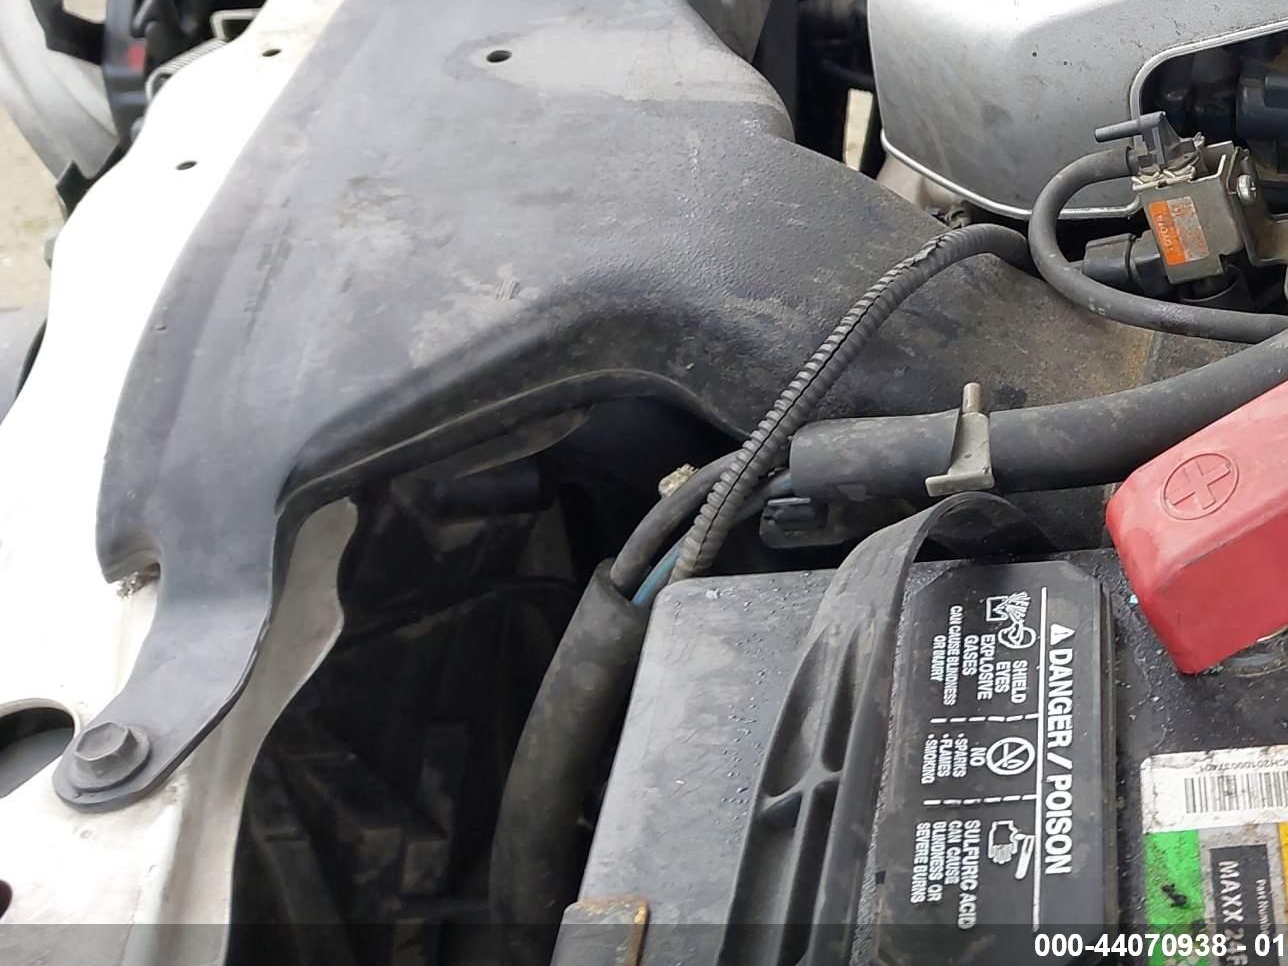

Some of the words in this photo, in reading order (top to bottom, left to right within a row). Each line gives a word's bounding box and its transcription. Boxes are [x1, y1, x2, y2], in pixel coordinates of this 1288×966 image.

[949, 606, 962, 624] CAN
[932, 636, 945, 649] OR
[947, 626, 960, 655] CAUSE
[962, 635, 978, 675] GASES
[930, 650, 944, 681] INJURY
[943, 657, 958, 705] BLINDNESS
[977, 635, 995, 700] EXPLOSIVE
[994, 662, 1011, 693] EYES
[1011, 660, 1028, 703] SHIELD
[1046, 648, 1073, 749] DANGER
[969, 747, 985, 766] NO
[1046, 752, 1073, 769] /
[947, 820, 963, 842] CAN
[1044, 774, 1073, 874] POISON
[913, 823, 929, 864] SEVERE
[929, 822, 945, 880] BLINDNESS
[959, 820, 980, 890] SULFURIC
[944, 847, 960, 884] CAUSE
[909, 866, 927, 904] BURNS
[927, 884, 943, 902] OR
[1218, 859, 1244, 924] MAXX
[957, 893, 977, 929] ACID
